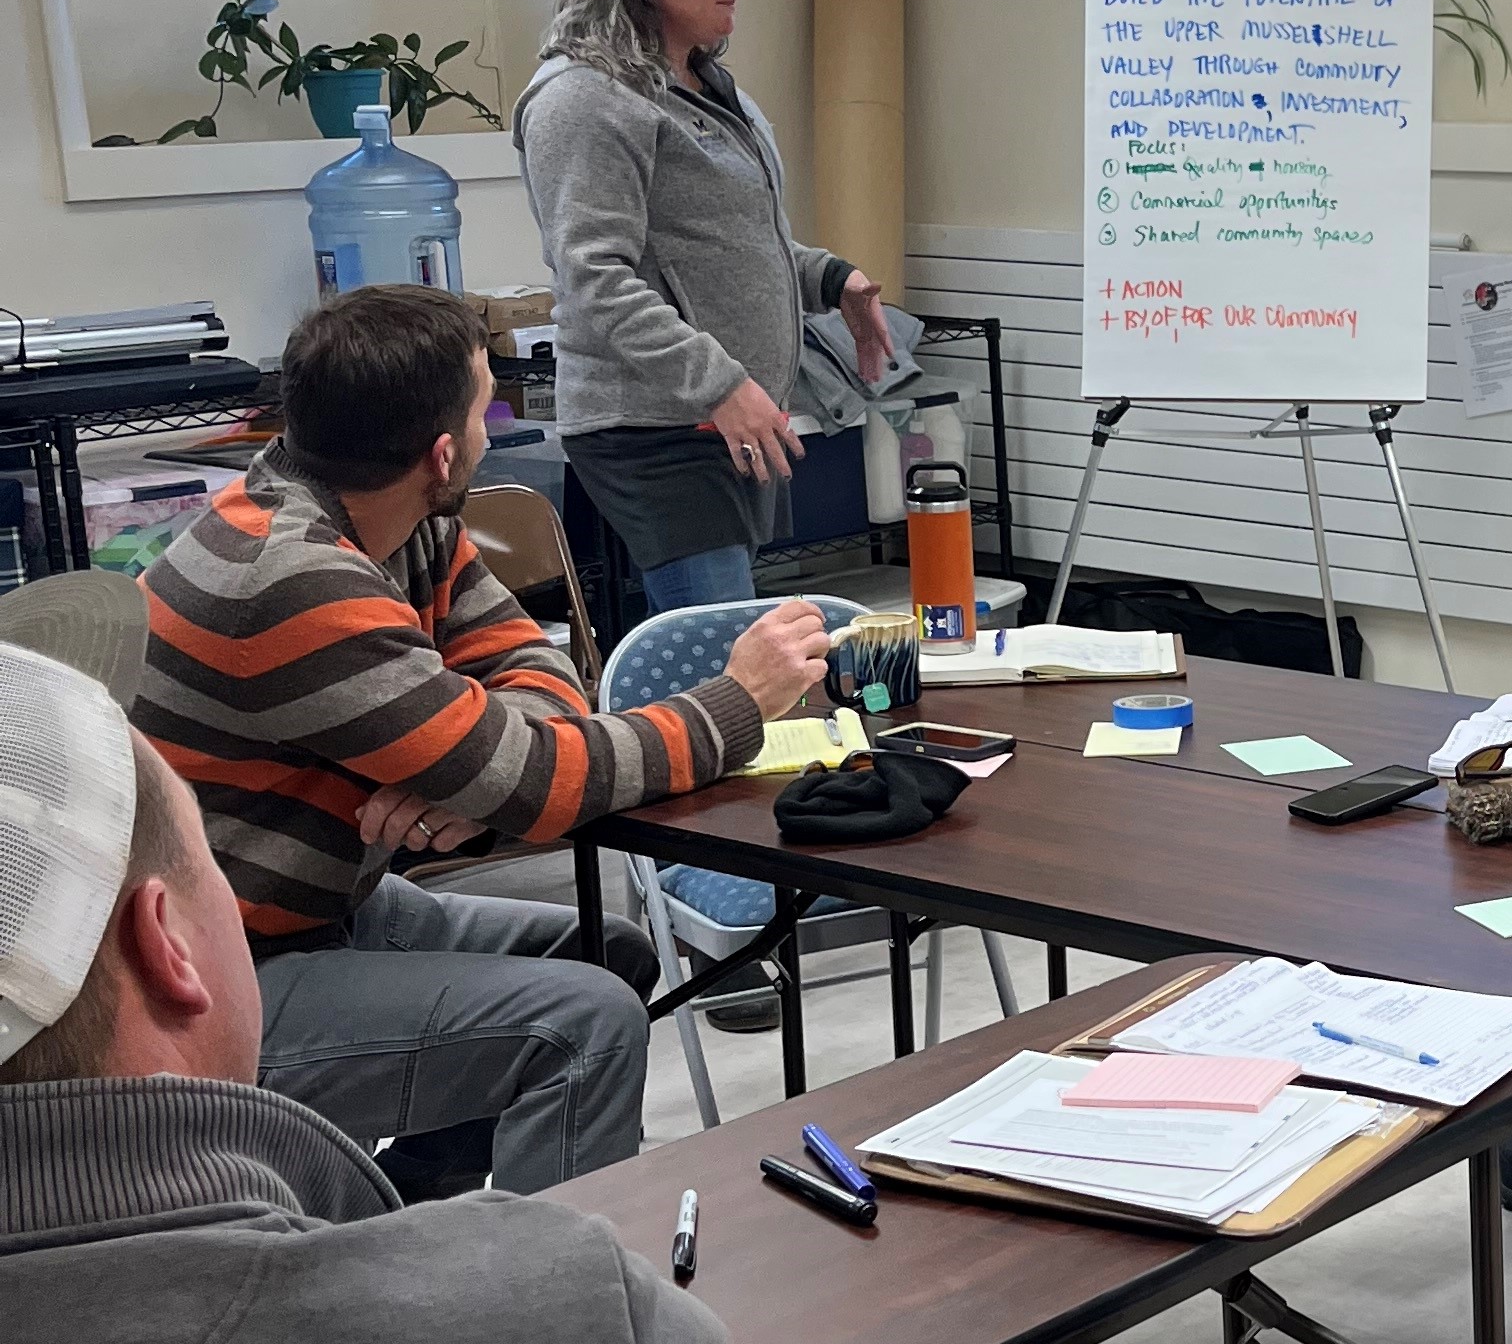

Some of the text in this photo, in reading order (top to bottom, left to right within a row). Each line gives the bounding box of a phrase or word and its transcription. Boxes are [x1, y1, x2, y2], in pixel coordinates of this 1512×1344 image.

[1102, 21, 1142, 43] THE
[1165, 21, 1224, 43] UPPER
[1101, 55, 1173, 80] VALLEY
[1194, 55, 1278, 76] THROUGH
[1111, 121, 1148, 138] AND
[1273, 159, 1333, 187] housing
[1131, 188, 1224, 210] Commercial
[1133, 220, 1200, 247] Shared
[1217, 222, 1303, 246] community
[1122, 278, 1183, 300] ACTION
[1181, 306, 1213, 331] FOR
[1224, 304, 1257, 326] OUR
[1265, 304, 1357, 339] COMMUNITY
